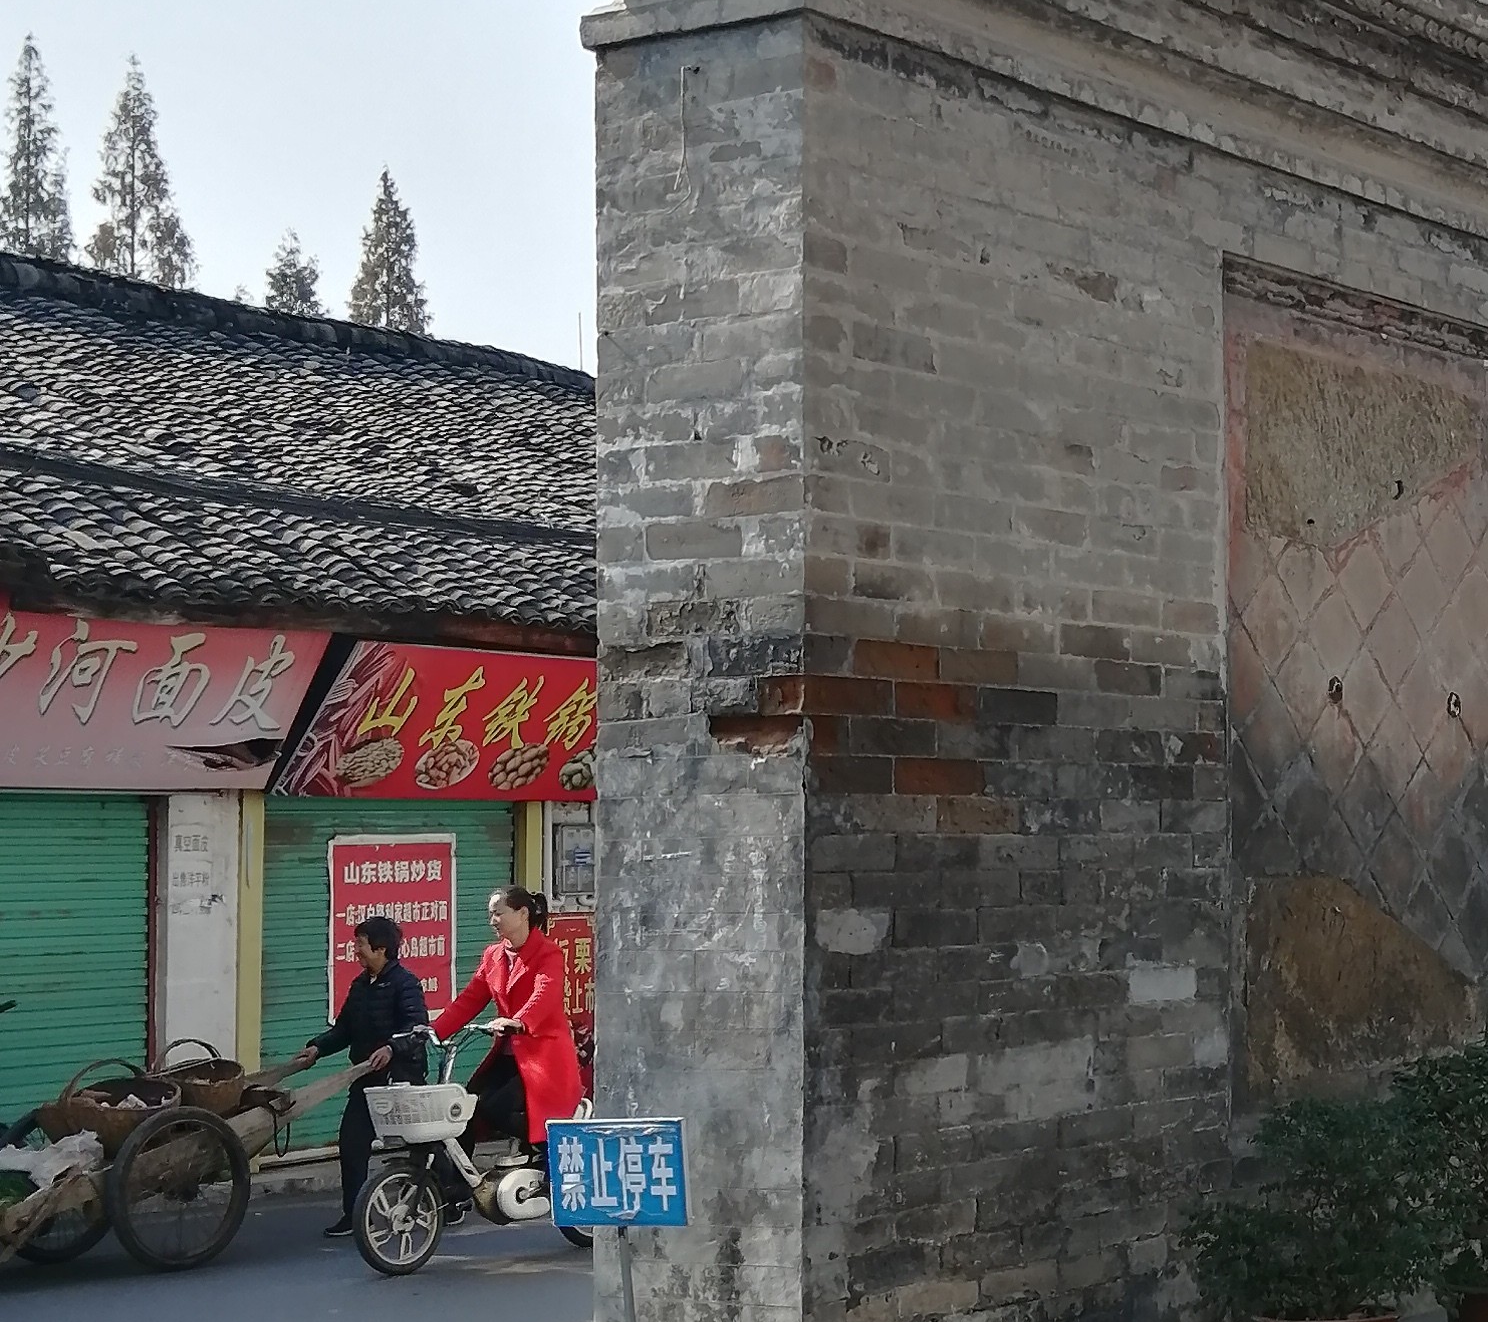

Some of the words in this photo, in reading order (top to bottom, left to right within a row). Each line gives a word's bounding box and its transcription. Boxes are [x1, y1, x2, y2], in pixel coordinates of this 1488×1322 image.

[344, 859, 442, 884] 山东铁锅炒货
[558, 1136, 677, 1213] 禁止停车
